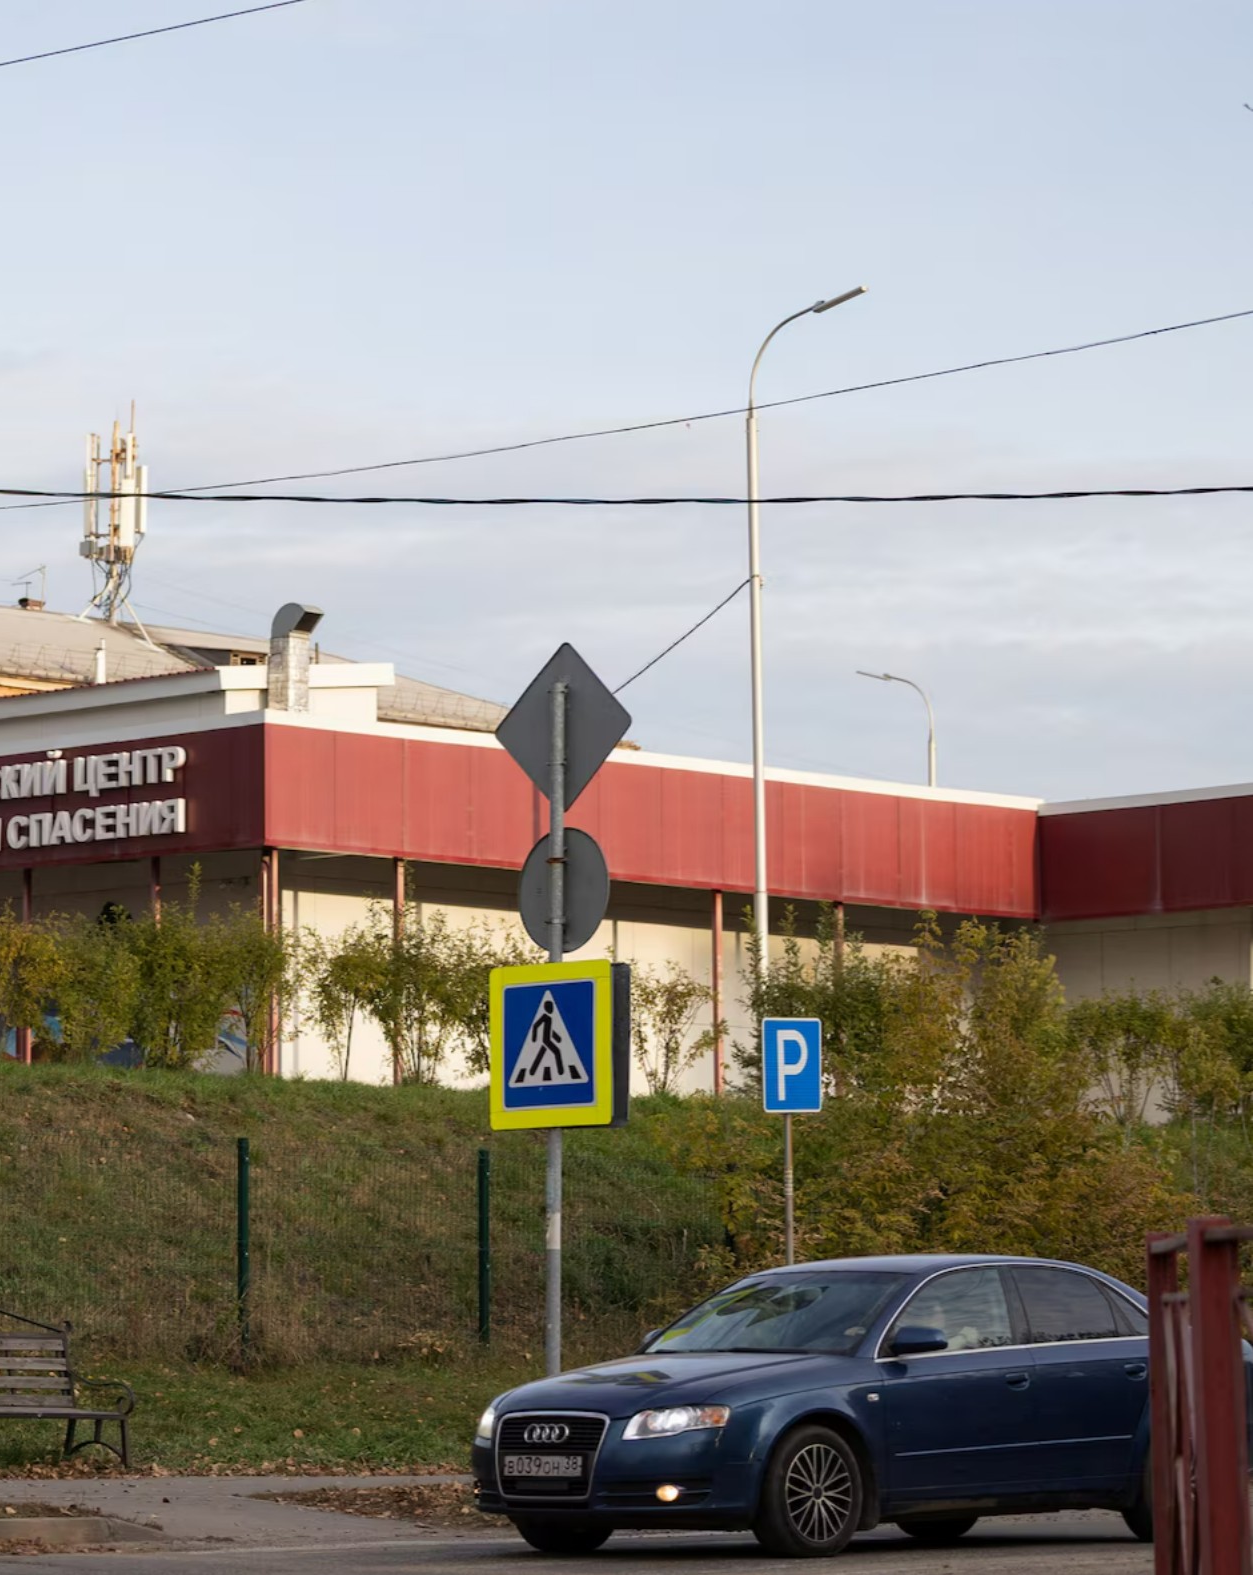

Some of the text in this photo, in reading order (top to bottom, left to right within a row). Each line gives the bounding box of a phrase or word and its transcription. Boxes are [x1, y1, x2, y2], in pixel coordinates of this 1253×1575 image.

[73, 746, 187, 797] ЦЕНТР
[6, 798, 187, 849] СПАСЕНИЯ
[776, 1029, 808, 1101] P
